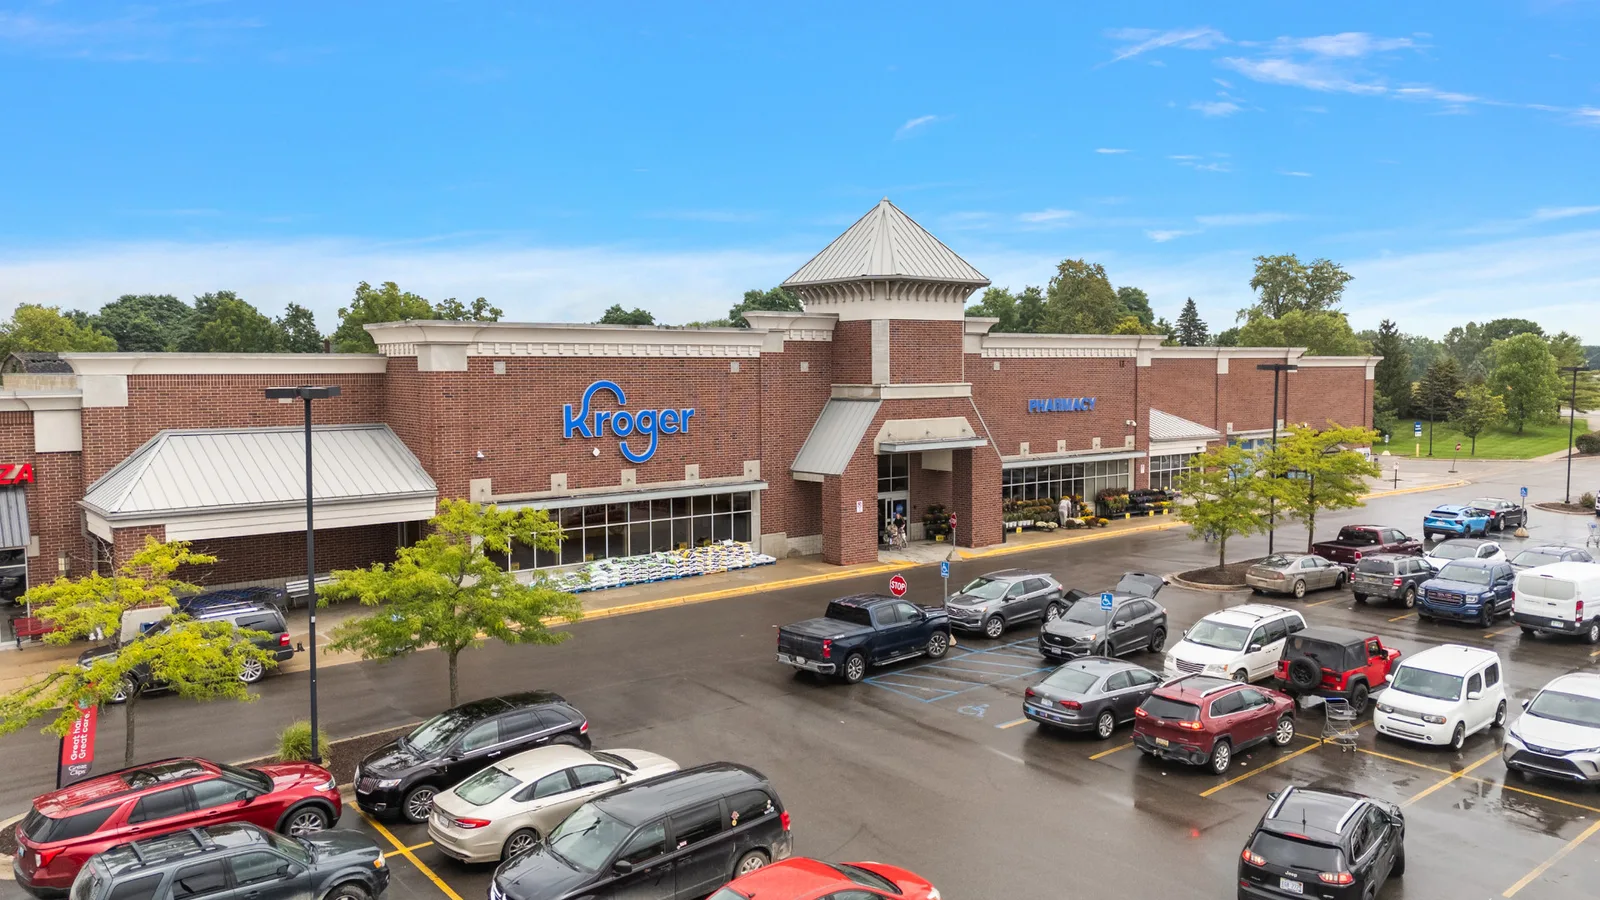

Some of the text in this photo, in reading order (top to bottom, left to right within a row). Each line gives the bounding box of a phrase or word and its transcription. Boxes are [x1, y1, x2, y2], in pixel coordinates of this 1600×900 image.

[1028, 397, 1097, 413] PHARMACY
[562, 380, 695, 464] Kroger
[891, 580, 906, 591] STOP
[71, 735, 80, 760] Great
[78, 711, 90, 759] Great care.
